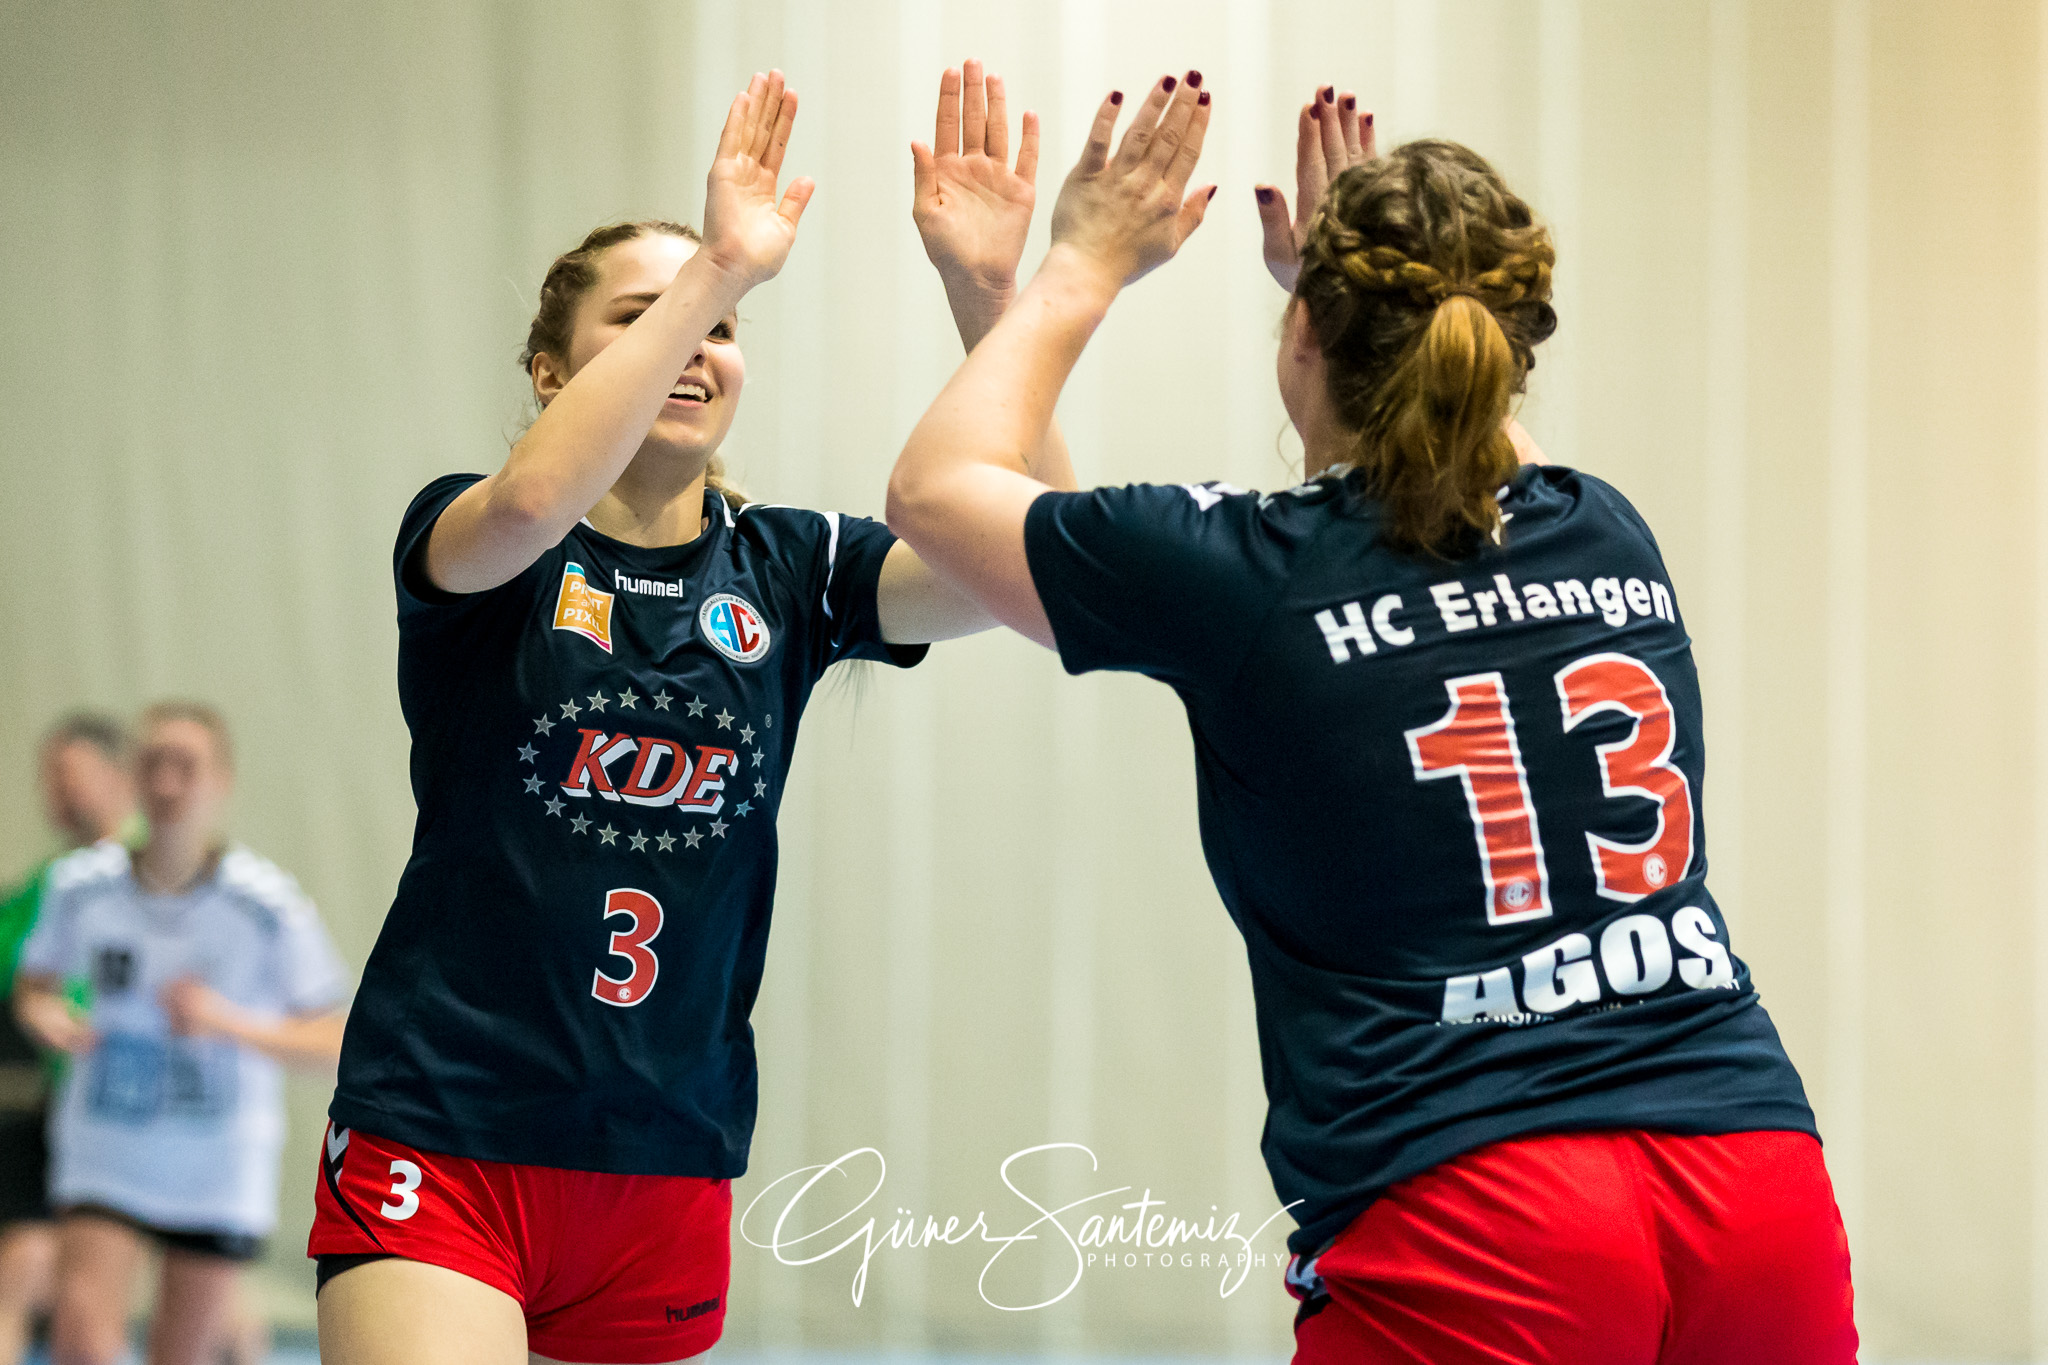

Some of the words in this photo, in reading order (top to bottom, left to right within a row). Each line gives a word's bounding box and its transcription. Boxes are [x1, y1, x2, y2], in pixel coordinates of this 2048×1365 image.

[615, 569, 683, 597] hummel
[1314, 595, 1415, 664] HC
[1429, 574, 1675, 632] Erlangen
[560, 728, 738, 814] KDE
[1404, 652, 1694, 925] 13
[591, 888, 664, 1007] 3
[1441, 906, 1733, 1022] AGOS
[380, 1160, 422, 1220] 3
